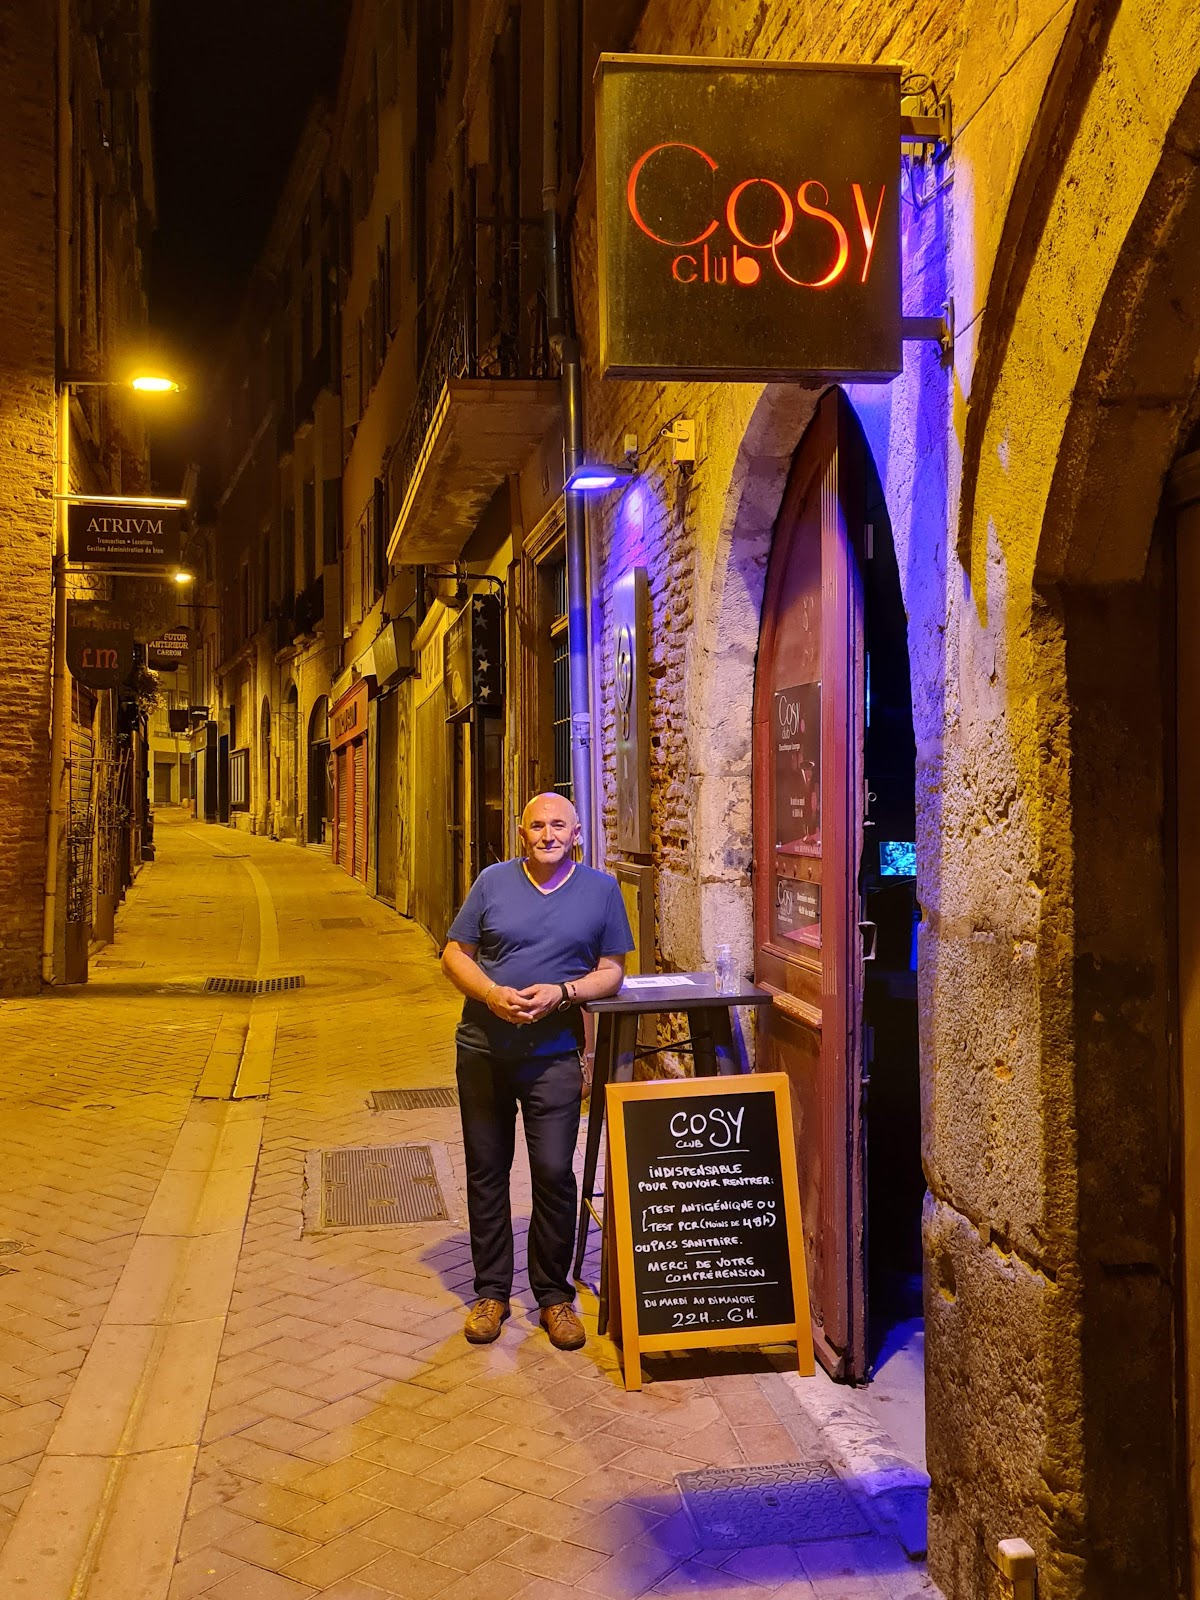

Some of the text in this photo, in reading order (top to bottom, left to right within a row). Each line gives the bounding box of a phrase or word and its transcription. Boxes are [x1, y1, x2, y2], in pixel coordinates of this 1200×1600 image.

[671, 243, 760, 285] club
[86, 517, 164, 535] ATRIVM
[97, 537, 126, 545] Transaction
[669, 1106, 745, 1148] COSY
[675, 1139, 704, 1149] CLUB
[638, 1182, 668, 1192] POUR
[757, 1200, 776, 1209] OU
[695, 1260, 711, 1269] DE
[716, 1256, 754, 1268] VOTRE
[644, 1299, 657, 1309] DU
